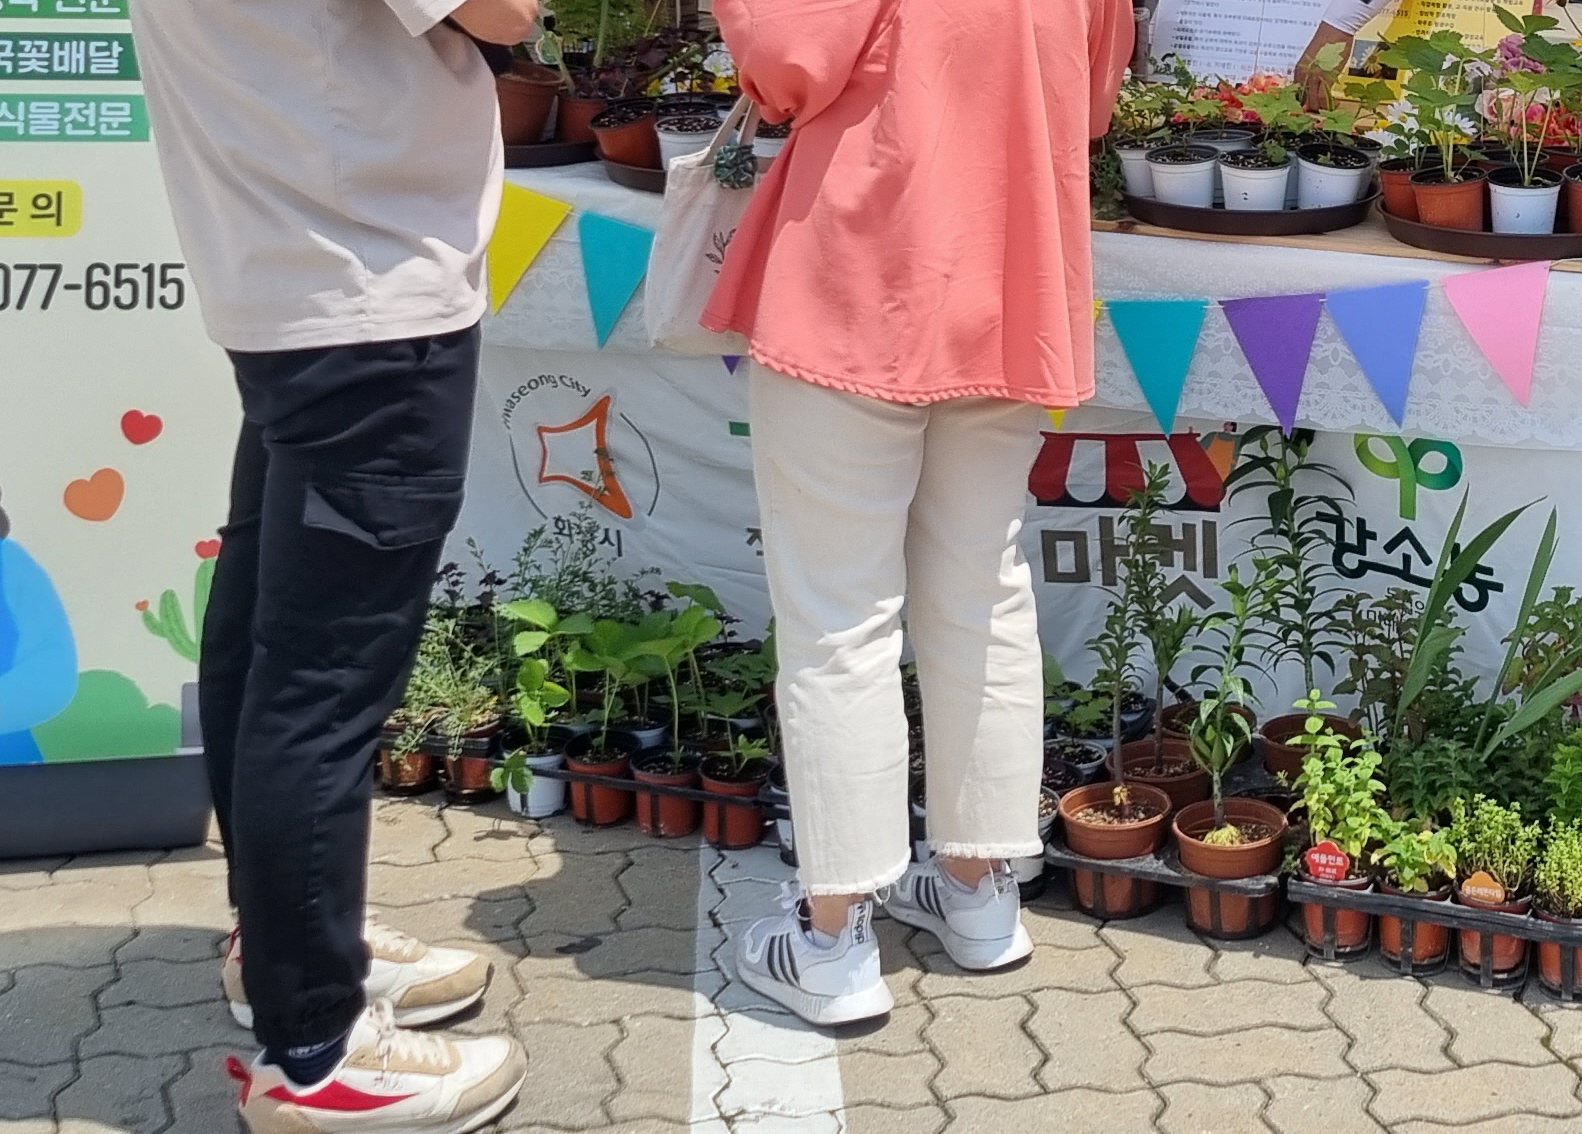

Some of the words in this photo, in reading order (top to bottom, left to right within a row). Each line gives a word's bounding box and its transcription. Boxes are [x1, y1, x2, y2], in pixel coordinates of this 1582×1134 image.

[0, 102, 133, 136] 식물전문
[559, 373, 592, 398] City
[1040, 515, 1219, 611] 마켓
